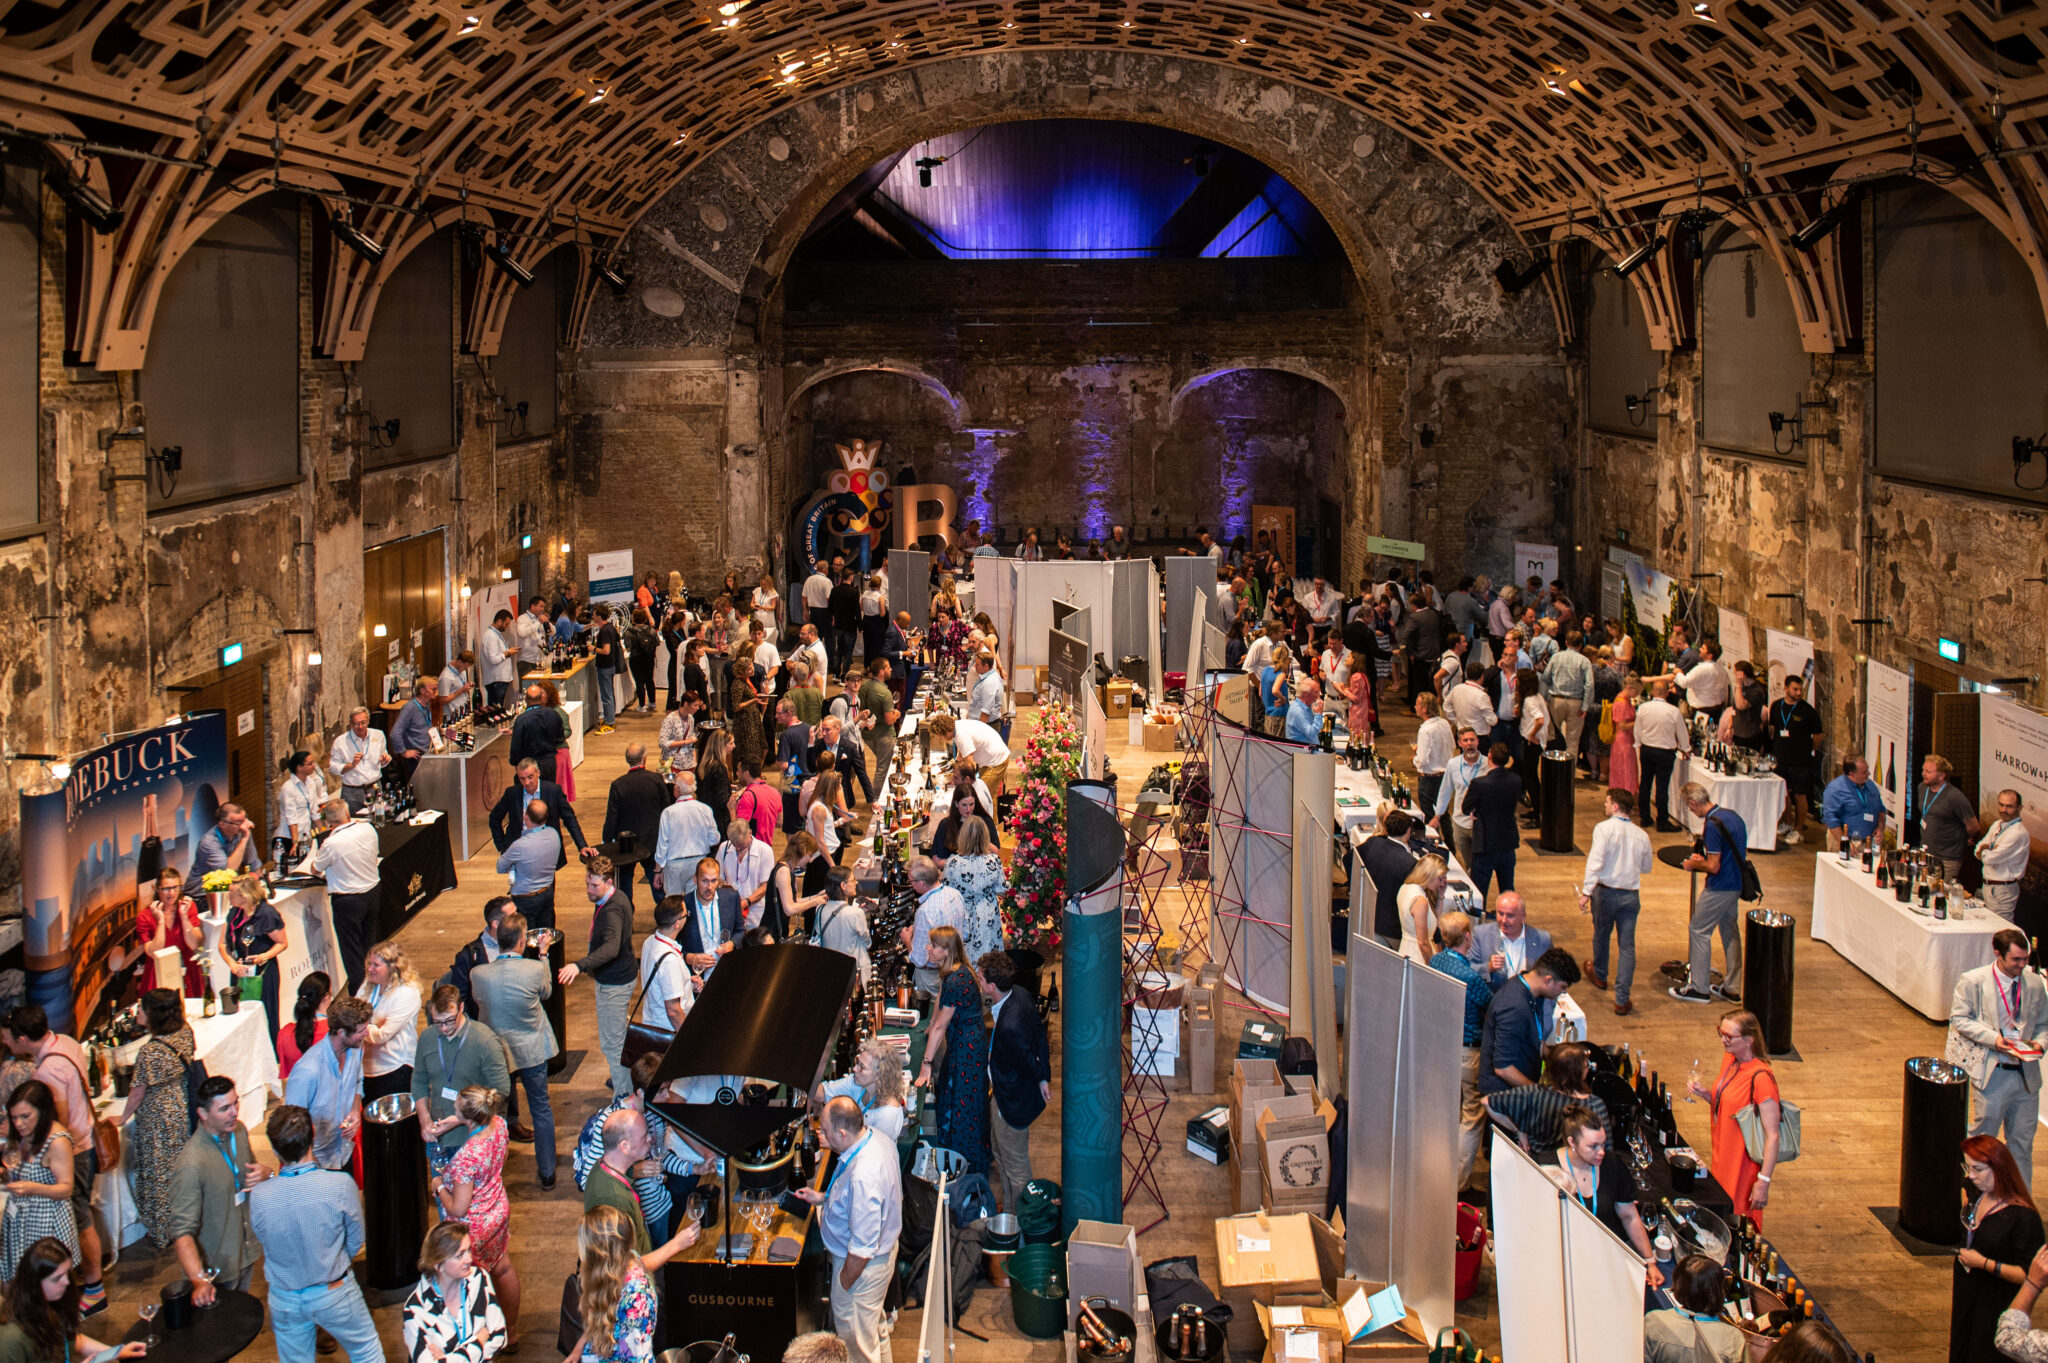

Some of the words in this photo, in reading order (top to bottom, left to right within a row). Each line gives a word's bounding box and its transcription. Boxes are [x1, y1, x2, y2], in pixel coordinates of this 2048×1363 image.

[805, 523, 815, 551] GREAT
[811, 498, 837, 522] BRITAIN
[687, 1293, 776, 1308] GUSBOURNE
